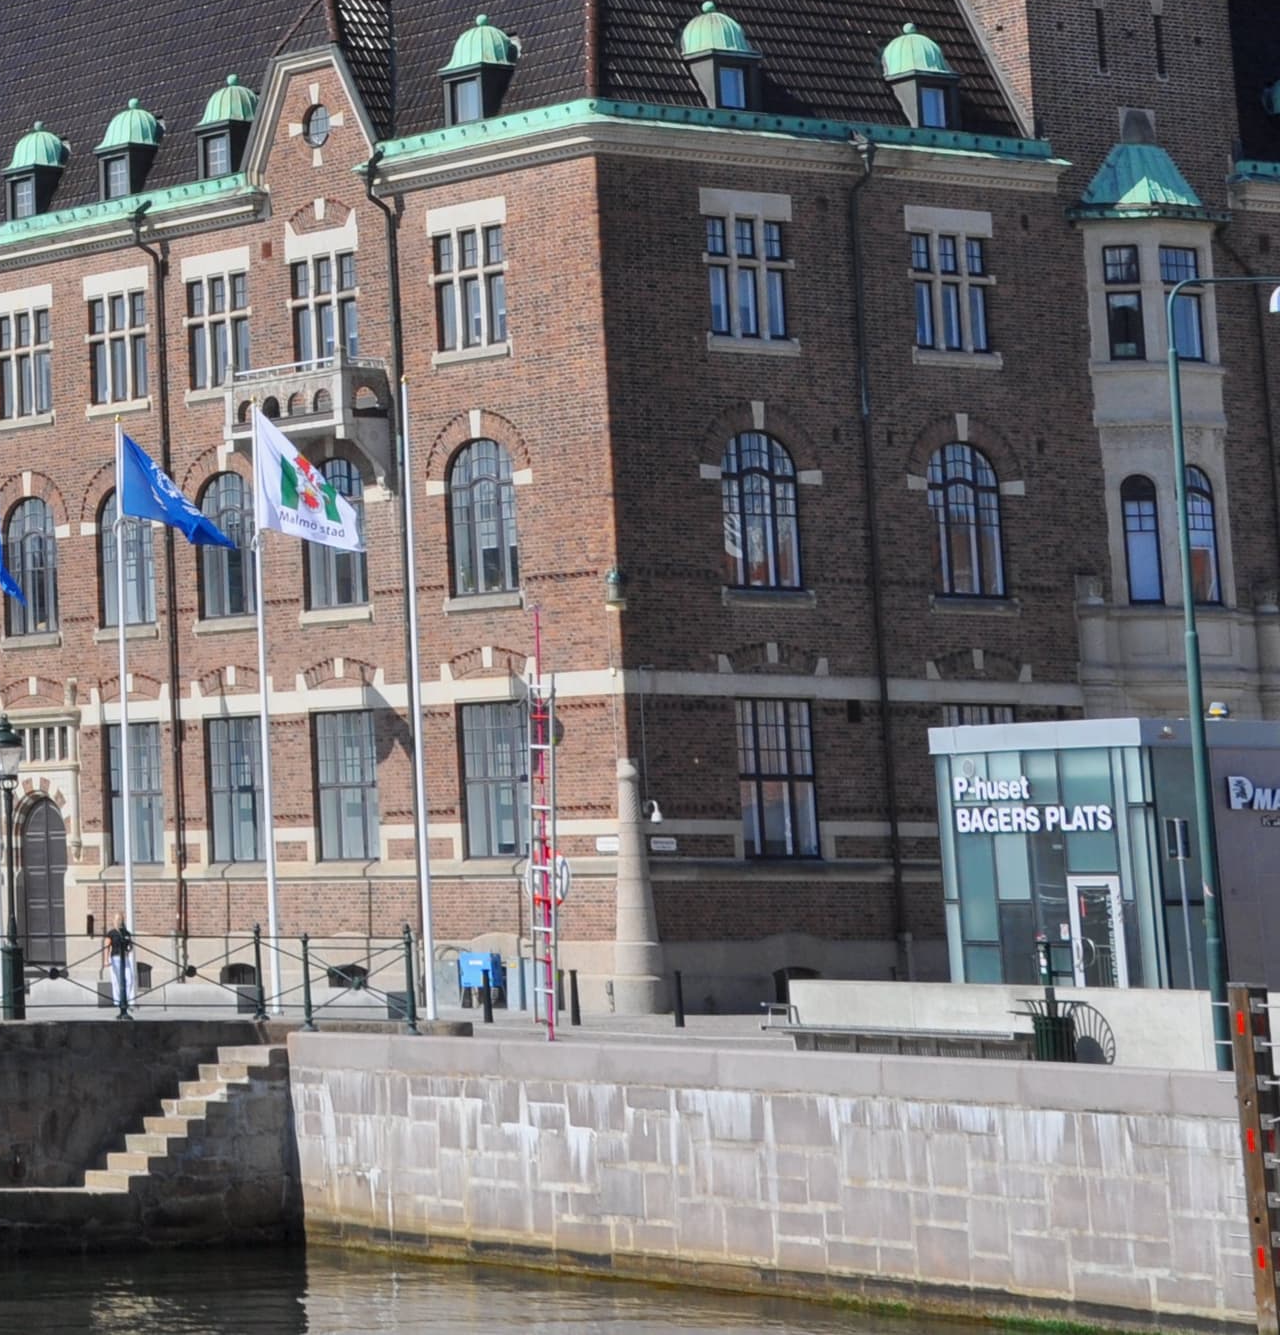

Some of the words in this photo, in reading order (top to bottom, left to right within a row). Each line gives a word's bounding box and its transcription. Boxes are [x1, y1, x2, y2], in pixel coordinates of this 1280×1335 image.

[320, 526, 345, 538] stad
[953, 776, 1030, 801] P-huset
[956, 806, 1041, 833] BAGERS
[1045, 804, 1112, 832] PLATS
